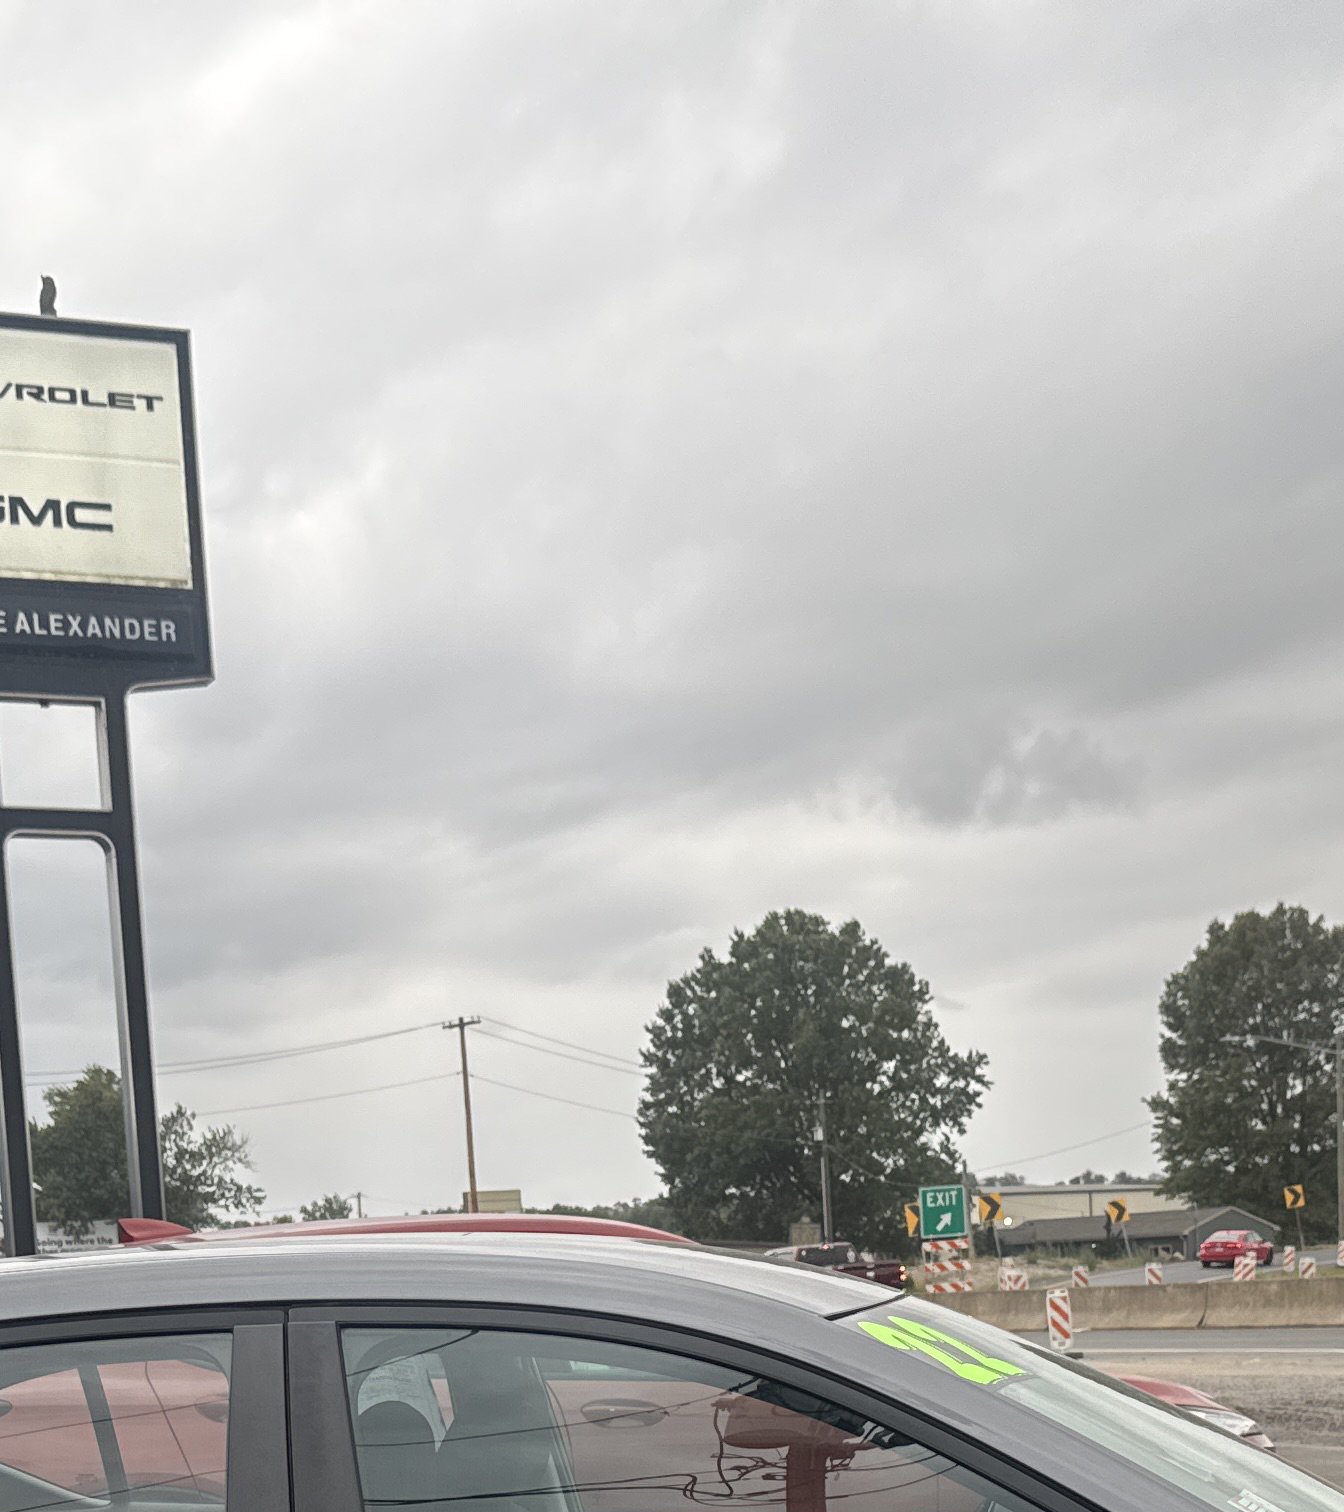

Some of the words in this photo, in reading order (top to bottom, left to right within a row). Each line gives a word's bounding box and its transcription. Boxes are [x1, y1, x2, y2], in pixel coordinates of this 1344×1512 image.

[14, 612, 177, 643] ALEXANDER
[925, 1190, 958, 1208] EXIT
[857, 1315, 1029, 1385] 22
